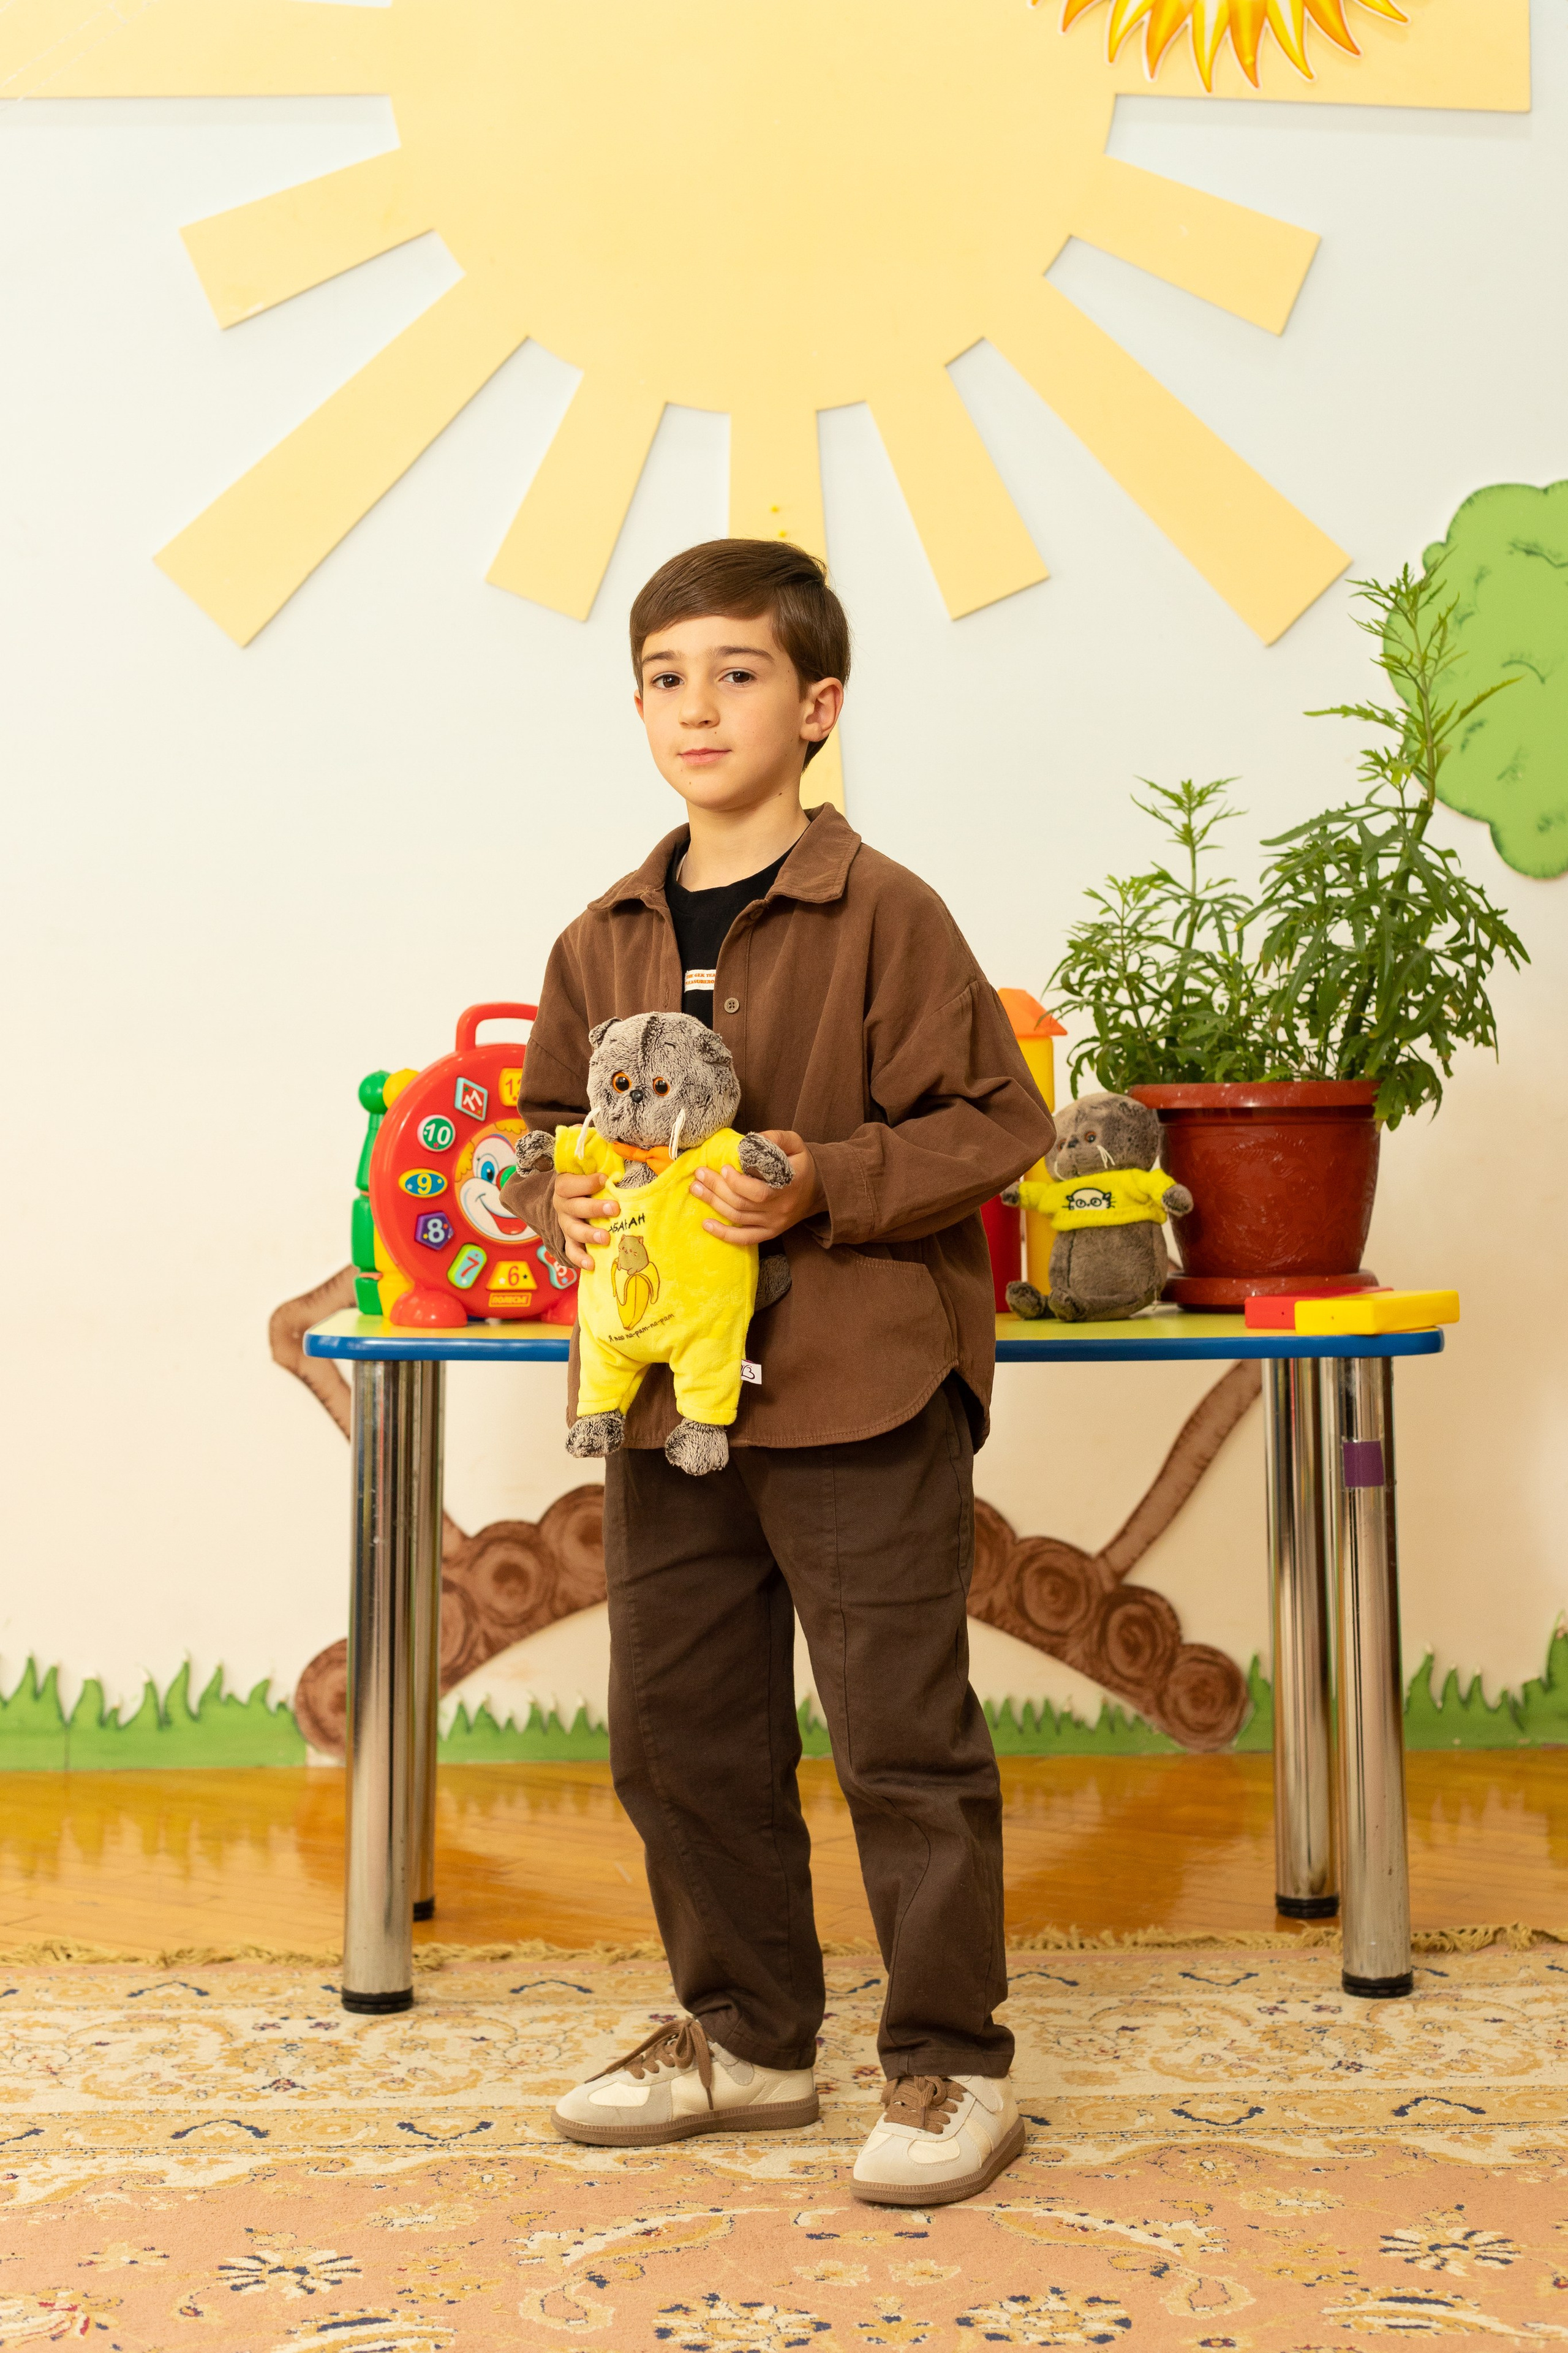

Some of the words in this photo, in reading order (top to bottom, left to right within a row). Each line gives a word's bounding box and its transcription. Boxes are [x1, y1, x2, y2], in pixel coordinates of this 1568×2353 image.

[463, 1089, 483, 1111] 11
[425, 1123, 451, 1145] 10
[417, 1173, 432, 1195] 9
[427, 1218, 445, 1243] 8
[461, 1256, 480, 1278] 7
[508, 1265, 519, 1286] 6
[552, 1260, 568, 1277] 5
